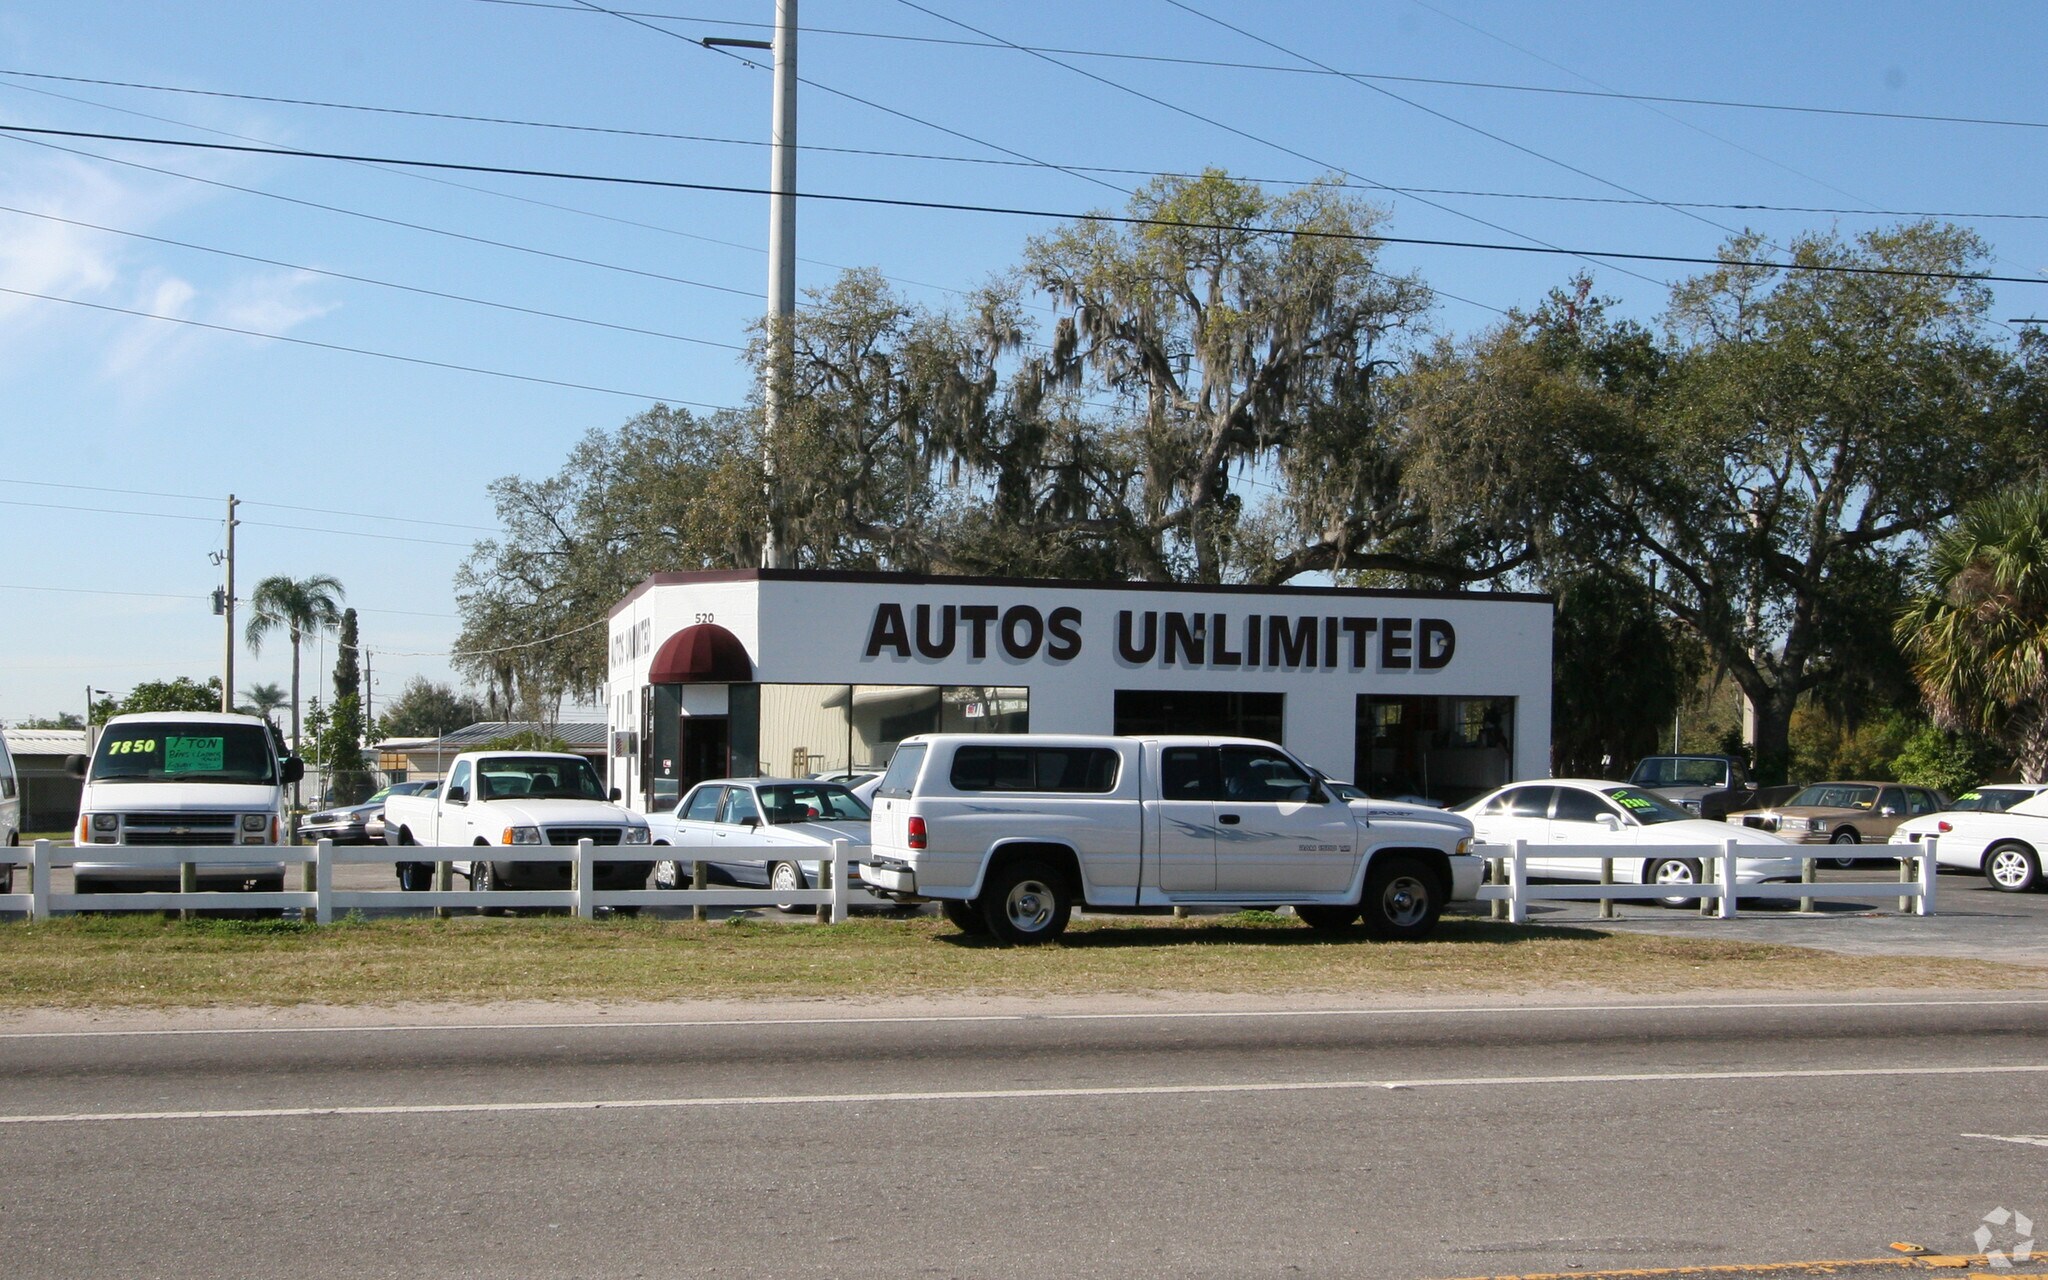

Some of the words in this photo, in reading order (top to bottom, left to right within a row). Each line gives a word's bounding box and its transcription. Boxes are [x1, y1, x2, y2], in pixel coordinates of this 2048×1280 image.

[695, 613, 715, 624] 520
[865, 603, 1082, 661] AUTOS
[1118, 610, 1456, 669] UNLIMITED
[109, 739, 155, 755] 7850
